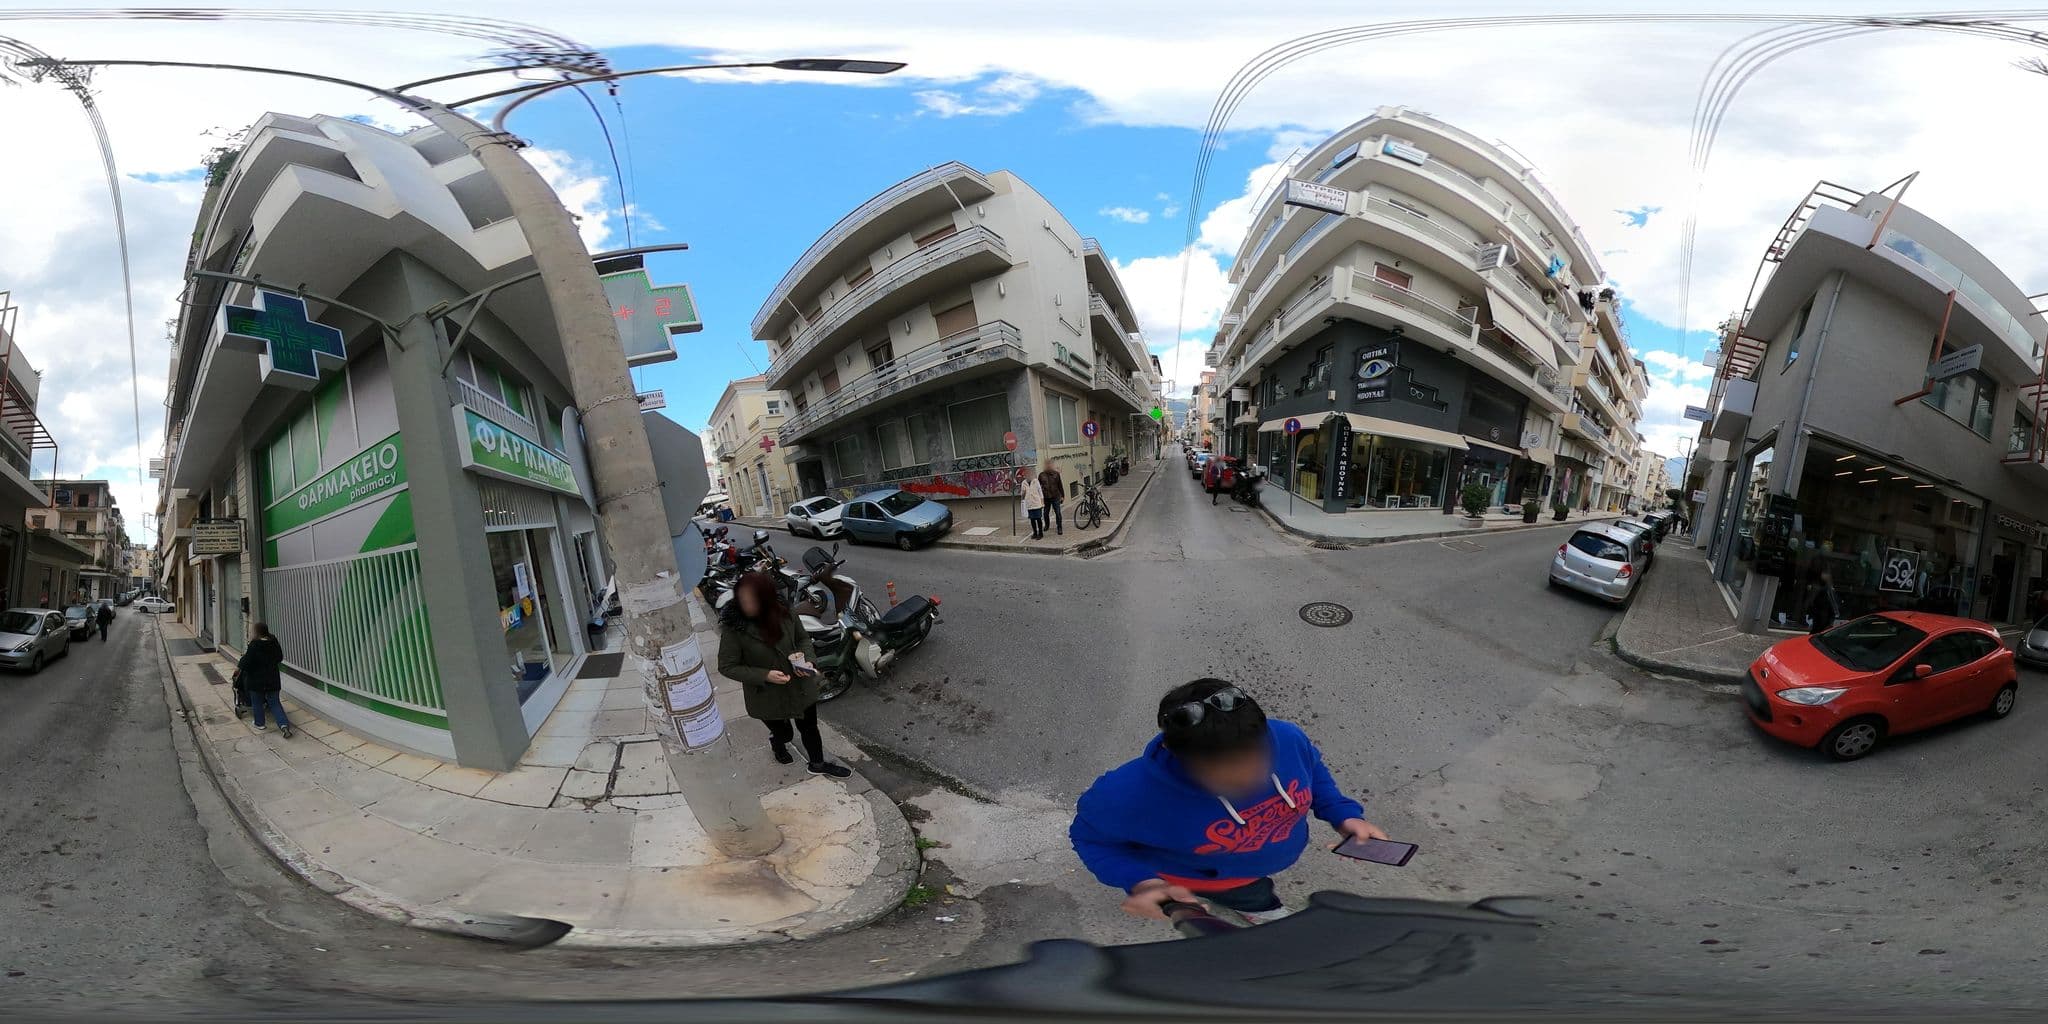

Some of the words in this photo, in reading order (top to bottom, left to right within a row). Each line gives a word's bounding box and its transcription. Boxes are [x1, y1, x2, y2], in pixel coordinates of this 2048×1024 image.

[1362, 348, 1387, 360] ΟΠΤΙΚΑ
[298, 443, 398, 510] ΦΑΡΜΑΚΕΙΟ
[350, 471, 397, 502] pharmacy
